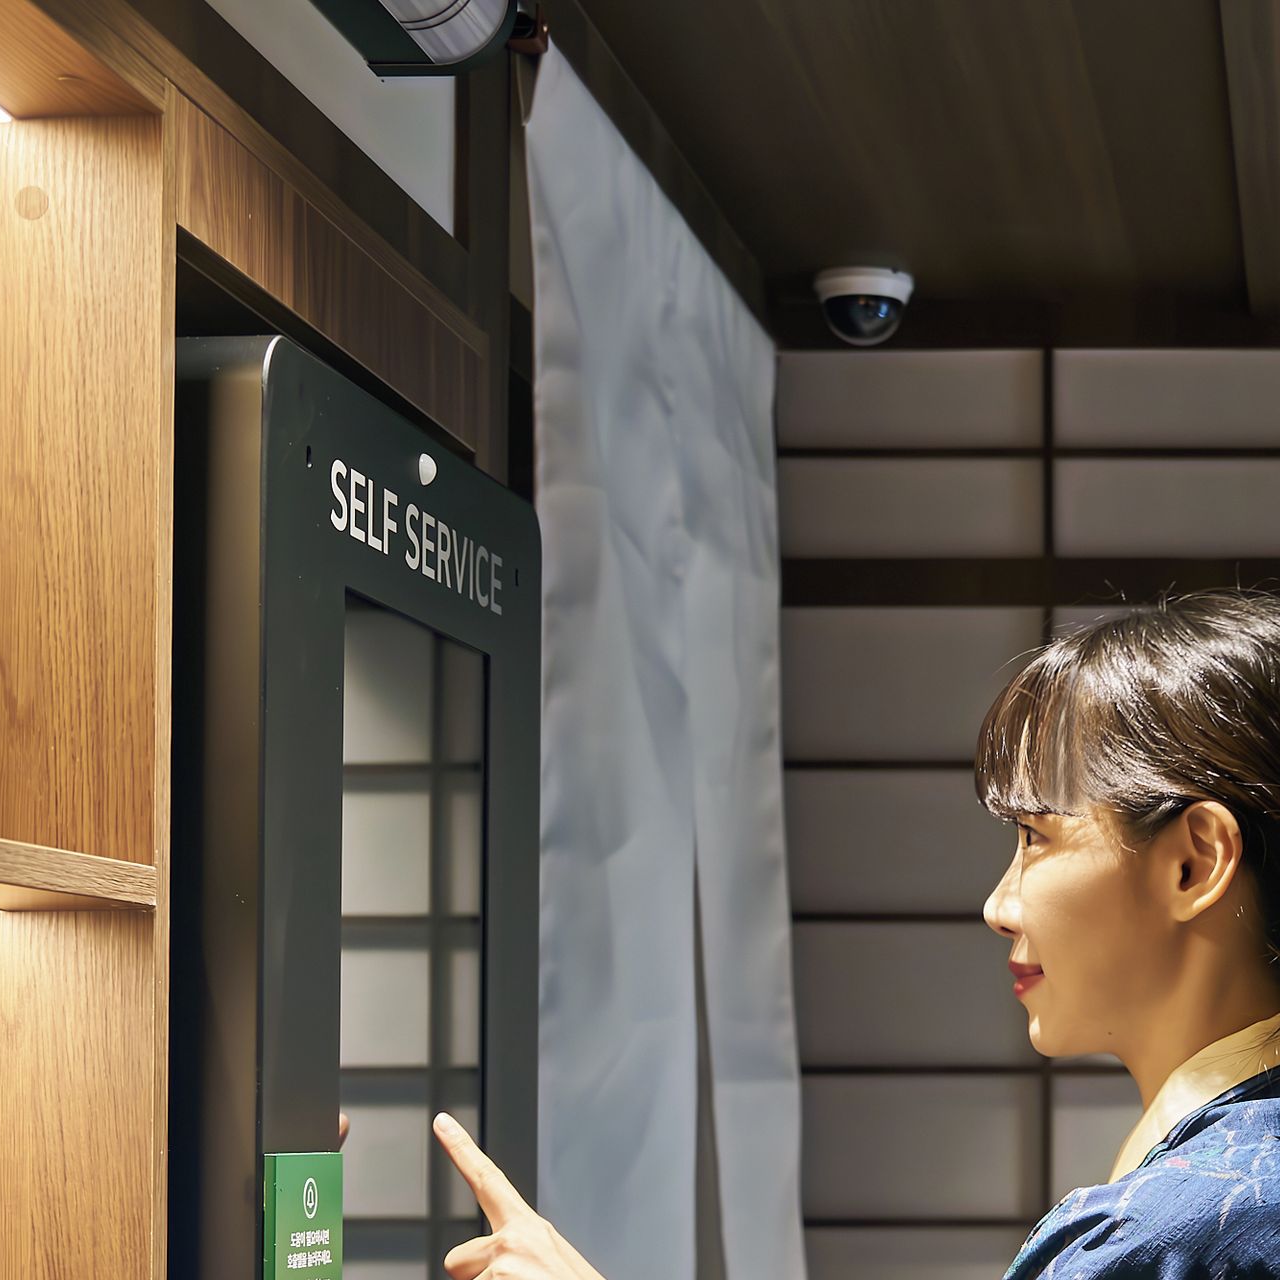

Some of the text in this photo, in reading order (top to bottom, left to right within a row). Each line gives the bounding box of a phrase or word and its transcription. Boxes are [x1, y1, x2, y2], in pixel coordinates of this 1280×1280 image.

[330, 459, 503, 616] SELF SERVICE
[290, 1229, 330, 1247] 도움이 필요하시면
